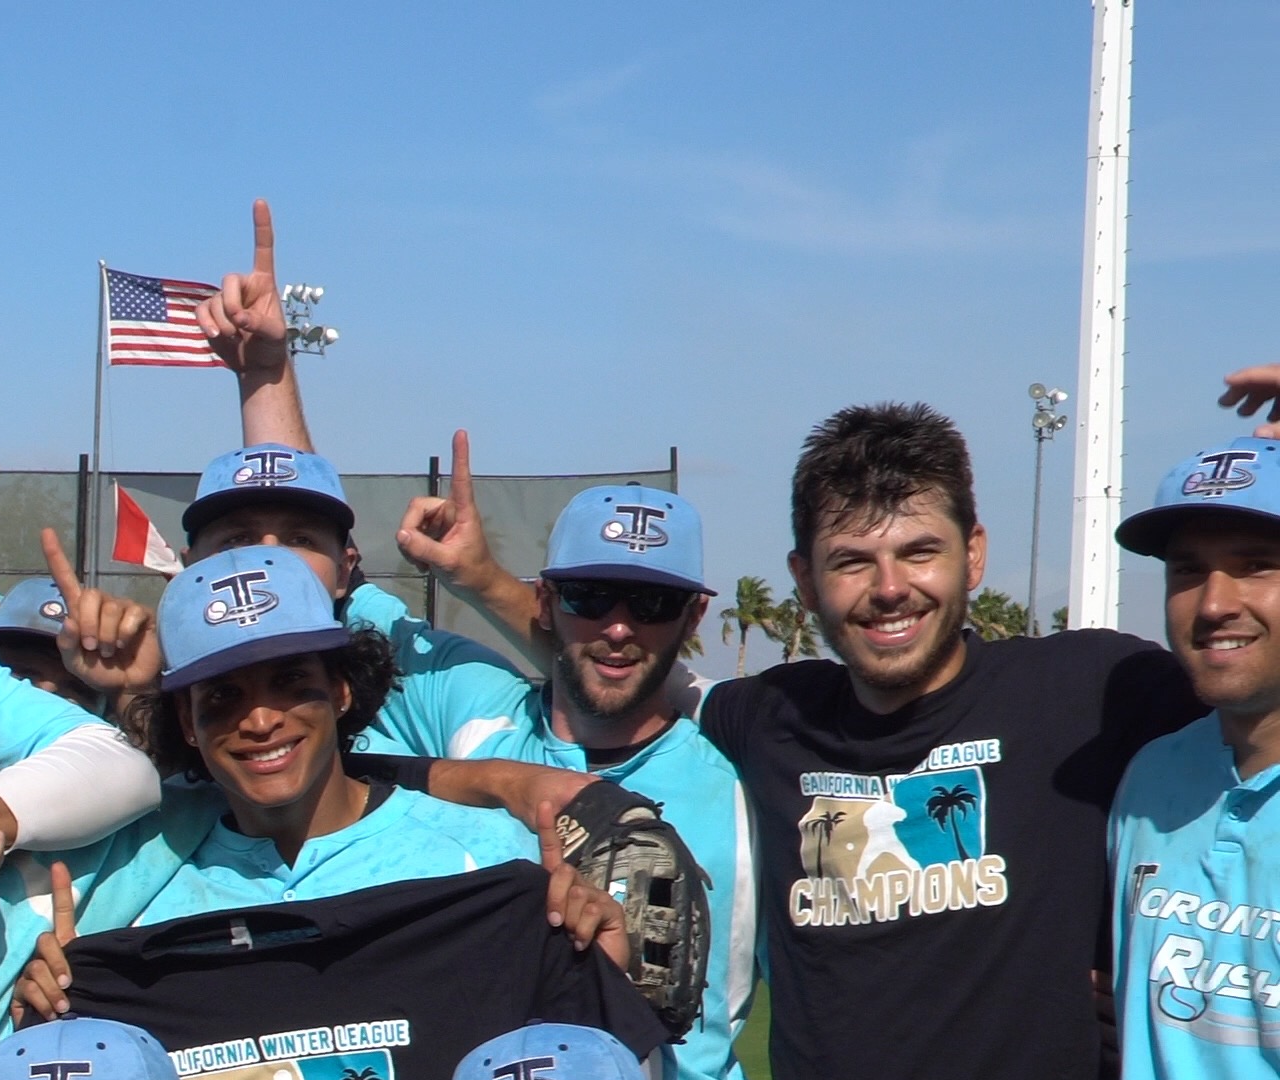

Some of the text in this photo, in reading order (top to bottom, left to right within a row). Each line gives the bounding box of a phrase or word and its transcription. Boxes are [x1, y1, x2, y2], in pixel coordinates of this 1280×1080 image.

[800, 772, 884, 798] CALIFORNIA
[927, 739, 1001, 771] LEAGUE
[790, 854, 1008, 927] CHAMPIONS
[261, 1027, 333, 1059] WINTER
[335, 1020, 410, 1048] LEAGUE
